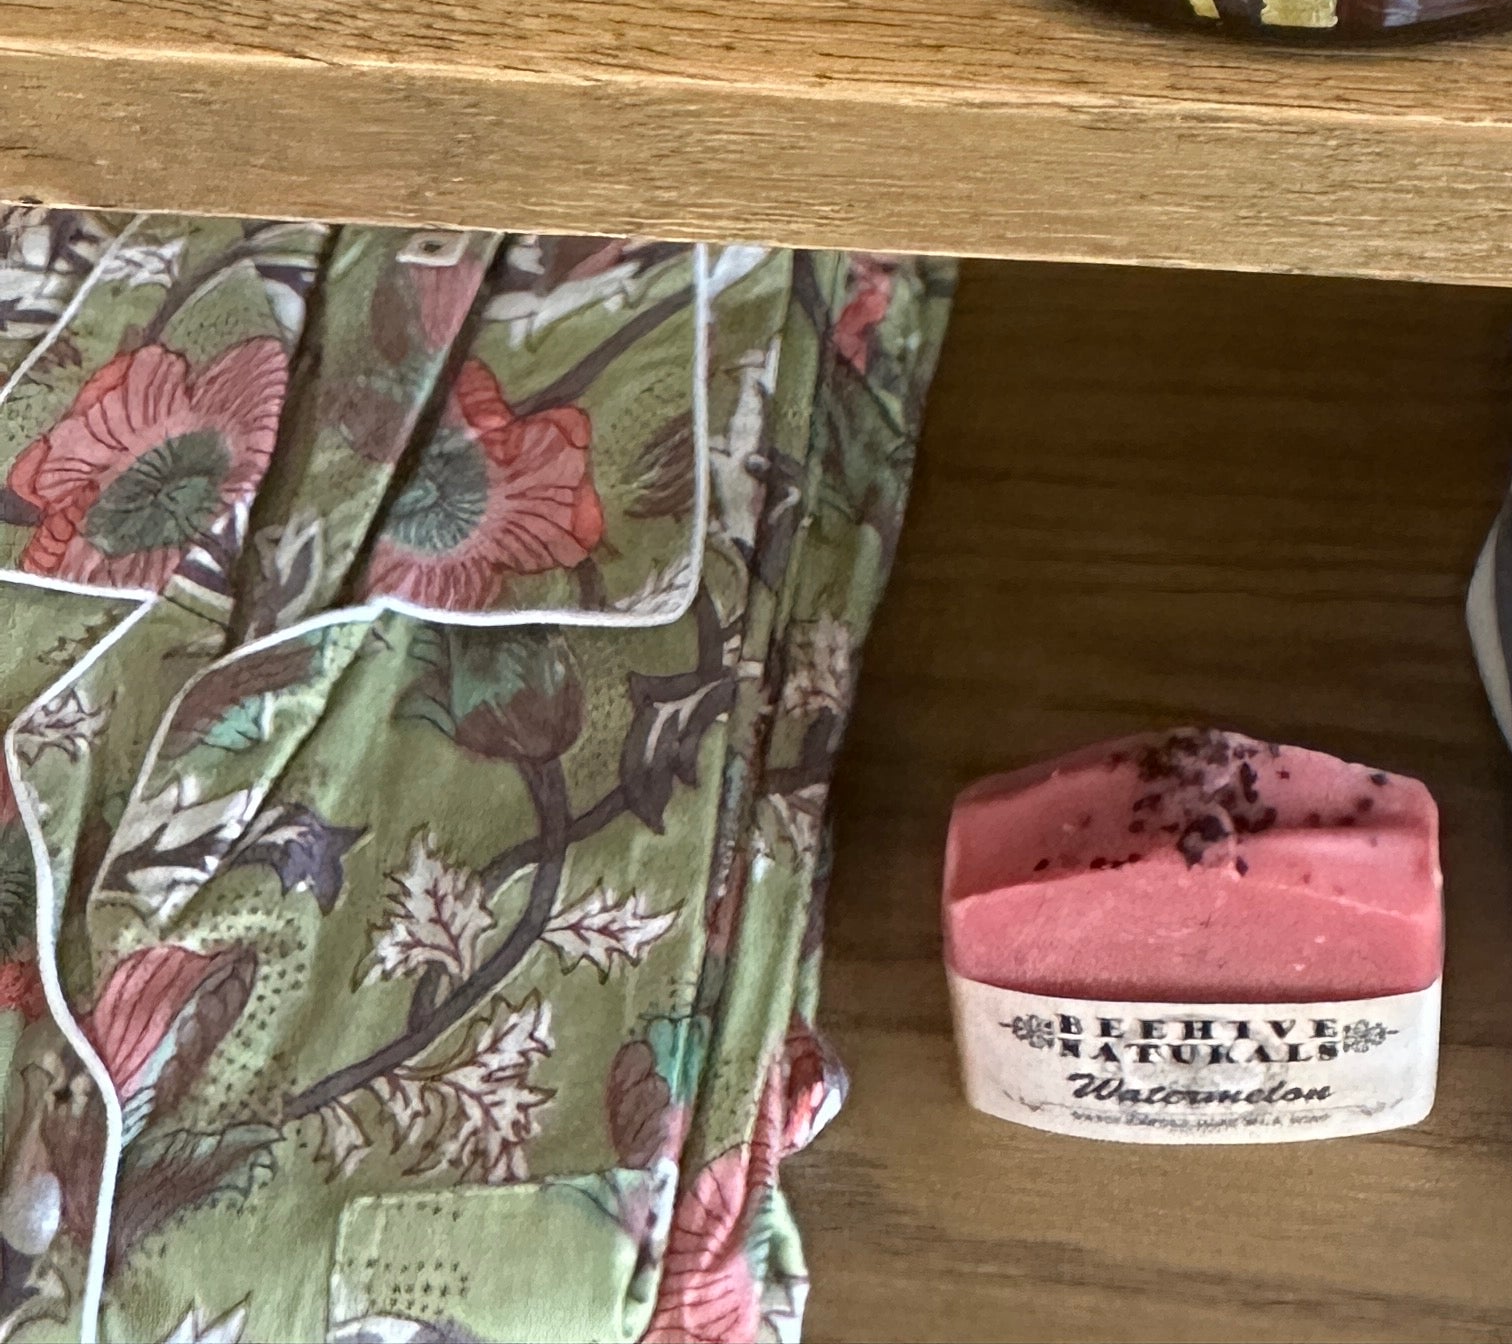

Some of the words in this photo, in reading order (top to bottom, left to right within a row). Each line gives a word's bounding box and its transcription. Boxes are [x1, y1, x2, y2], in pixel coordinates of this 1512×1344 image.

[1056, 1013, 1338, 1039] BEEHIVE
[1058, 1038, 1340, 1065] NATURALS
[1065, 1071, 1334, 1108] Watermelon
